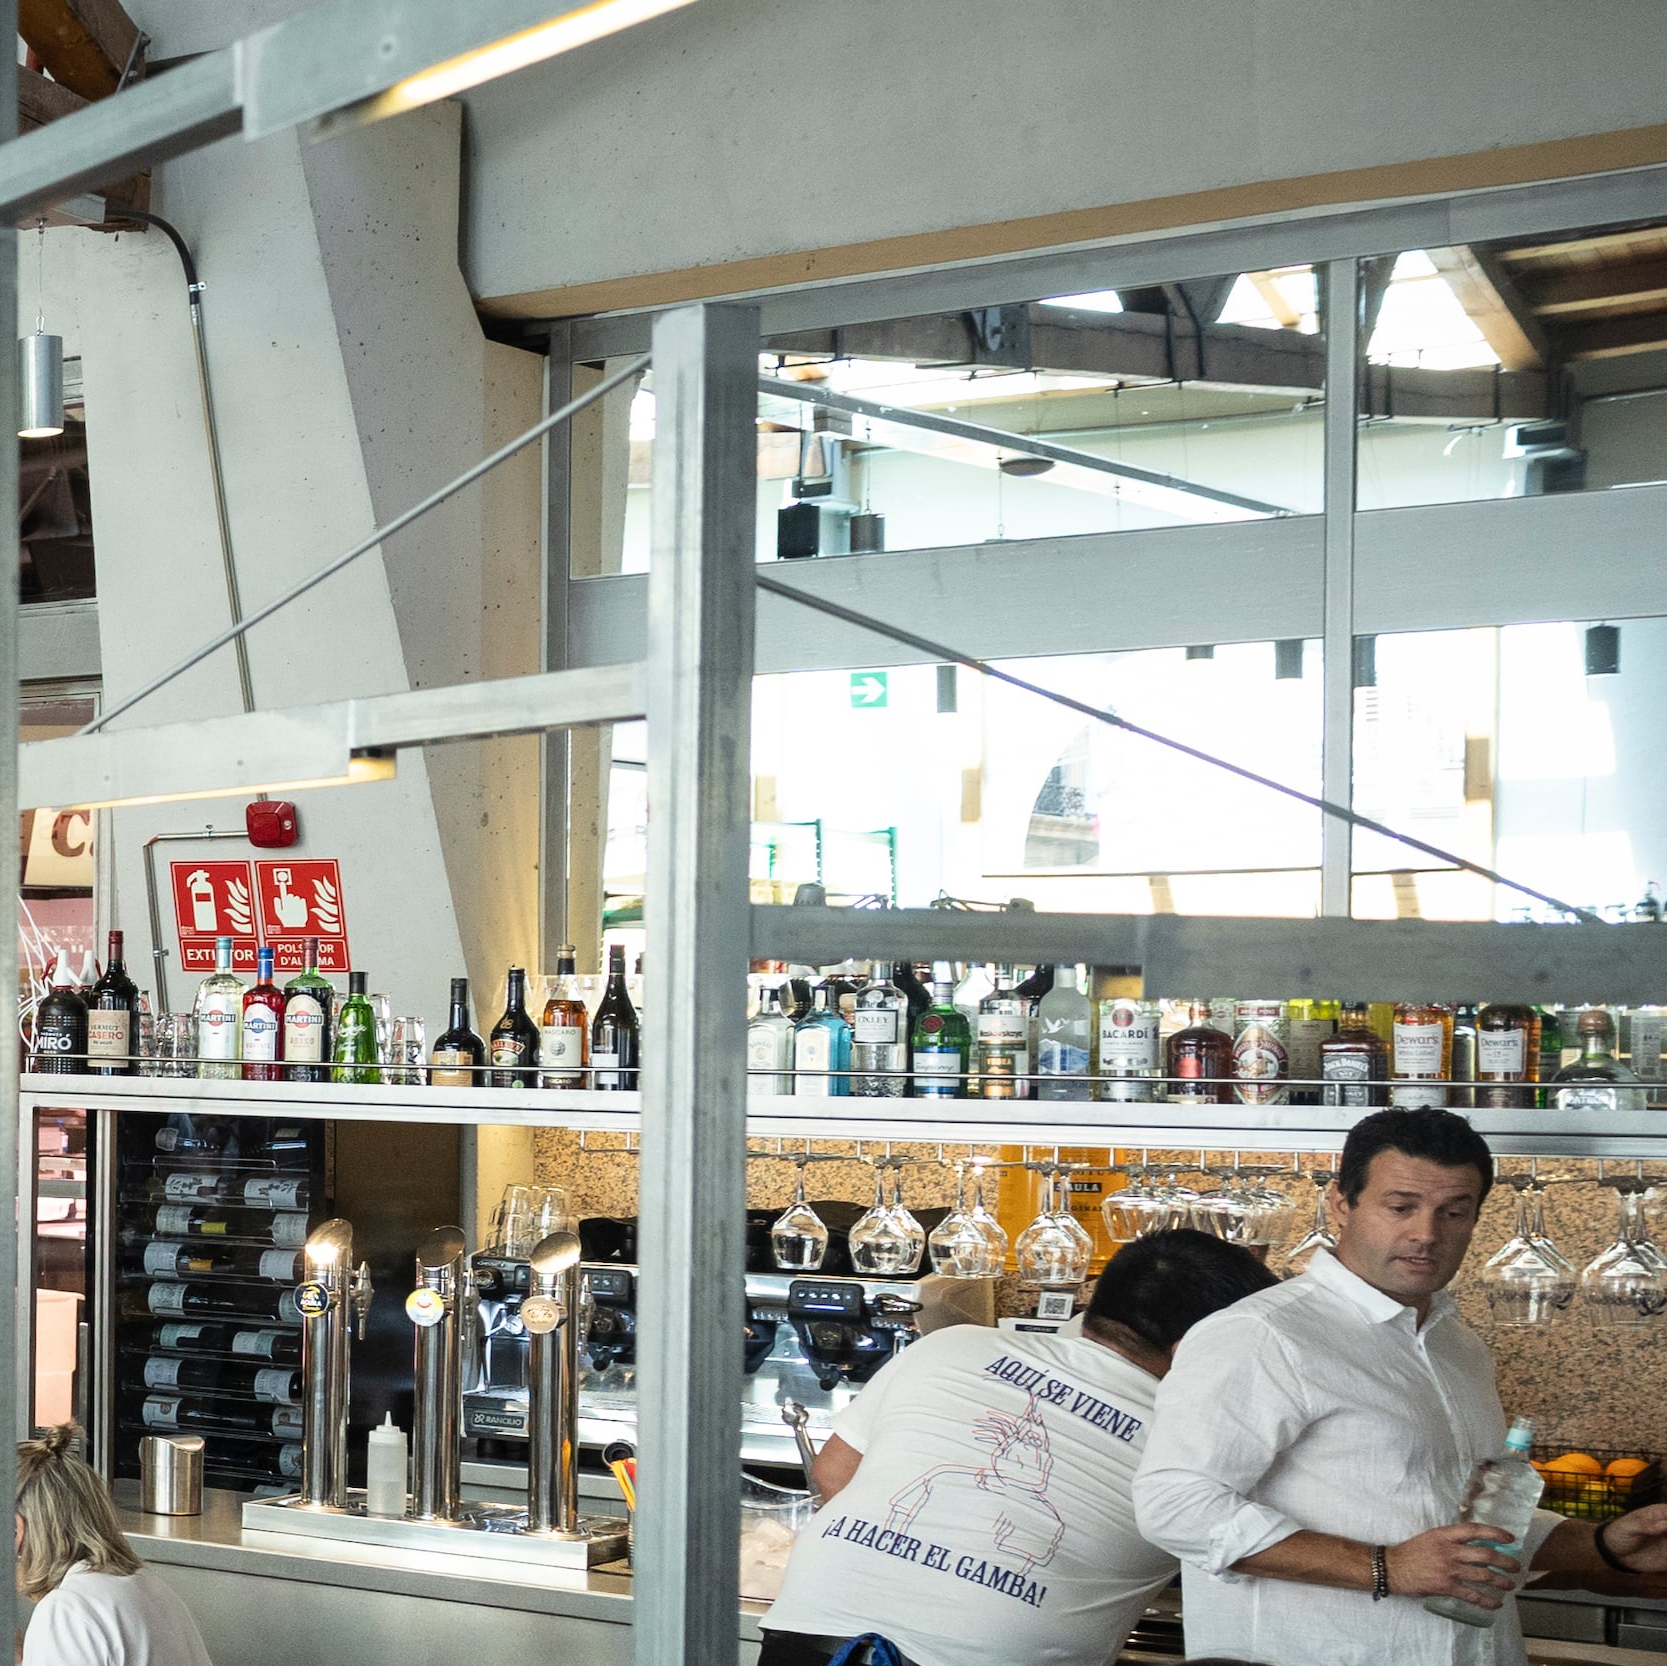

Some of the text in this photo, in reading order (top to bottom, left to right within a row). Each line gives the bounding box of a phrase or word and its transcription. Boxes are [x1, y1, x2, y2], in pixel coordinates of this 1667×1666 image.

[277, 943, 335, 953] POLSOR
[186, 949, 255, 962] EXTIOR
[280, 956, 335, 966] D'ALMA
[201, 1013, 236, 1023] MARTINI
[285, 1014, 323, 1025] MARTINI
[244, 1021, 277, 1031] MARTINI
[984, 1355, 1143, 1444] AQUÍ SE VIENE
[485, 1415, 523, 1427] RANCILIO
[821, 1516, 1048, 1609] ¡A HACER EL GAMBA!
